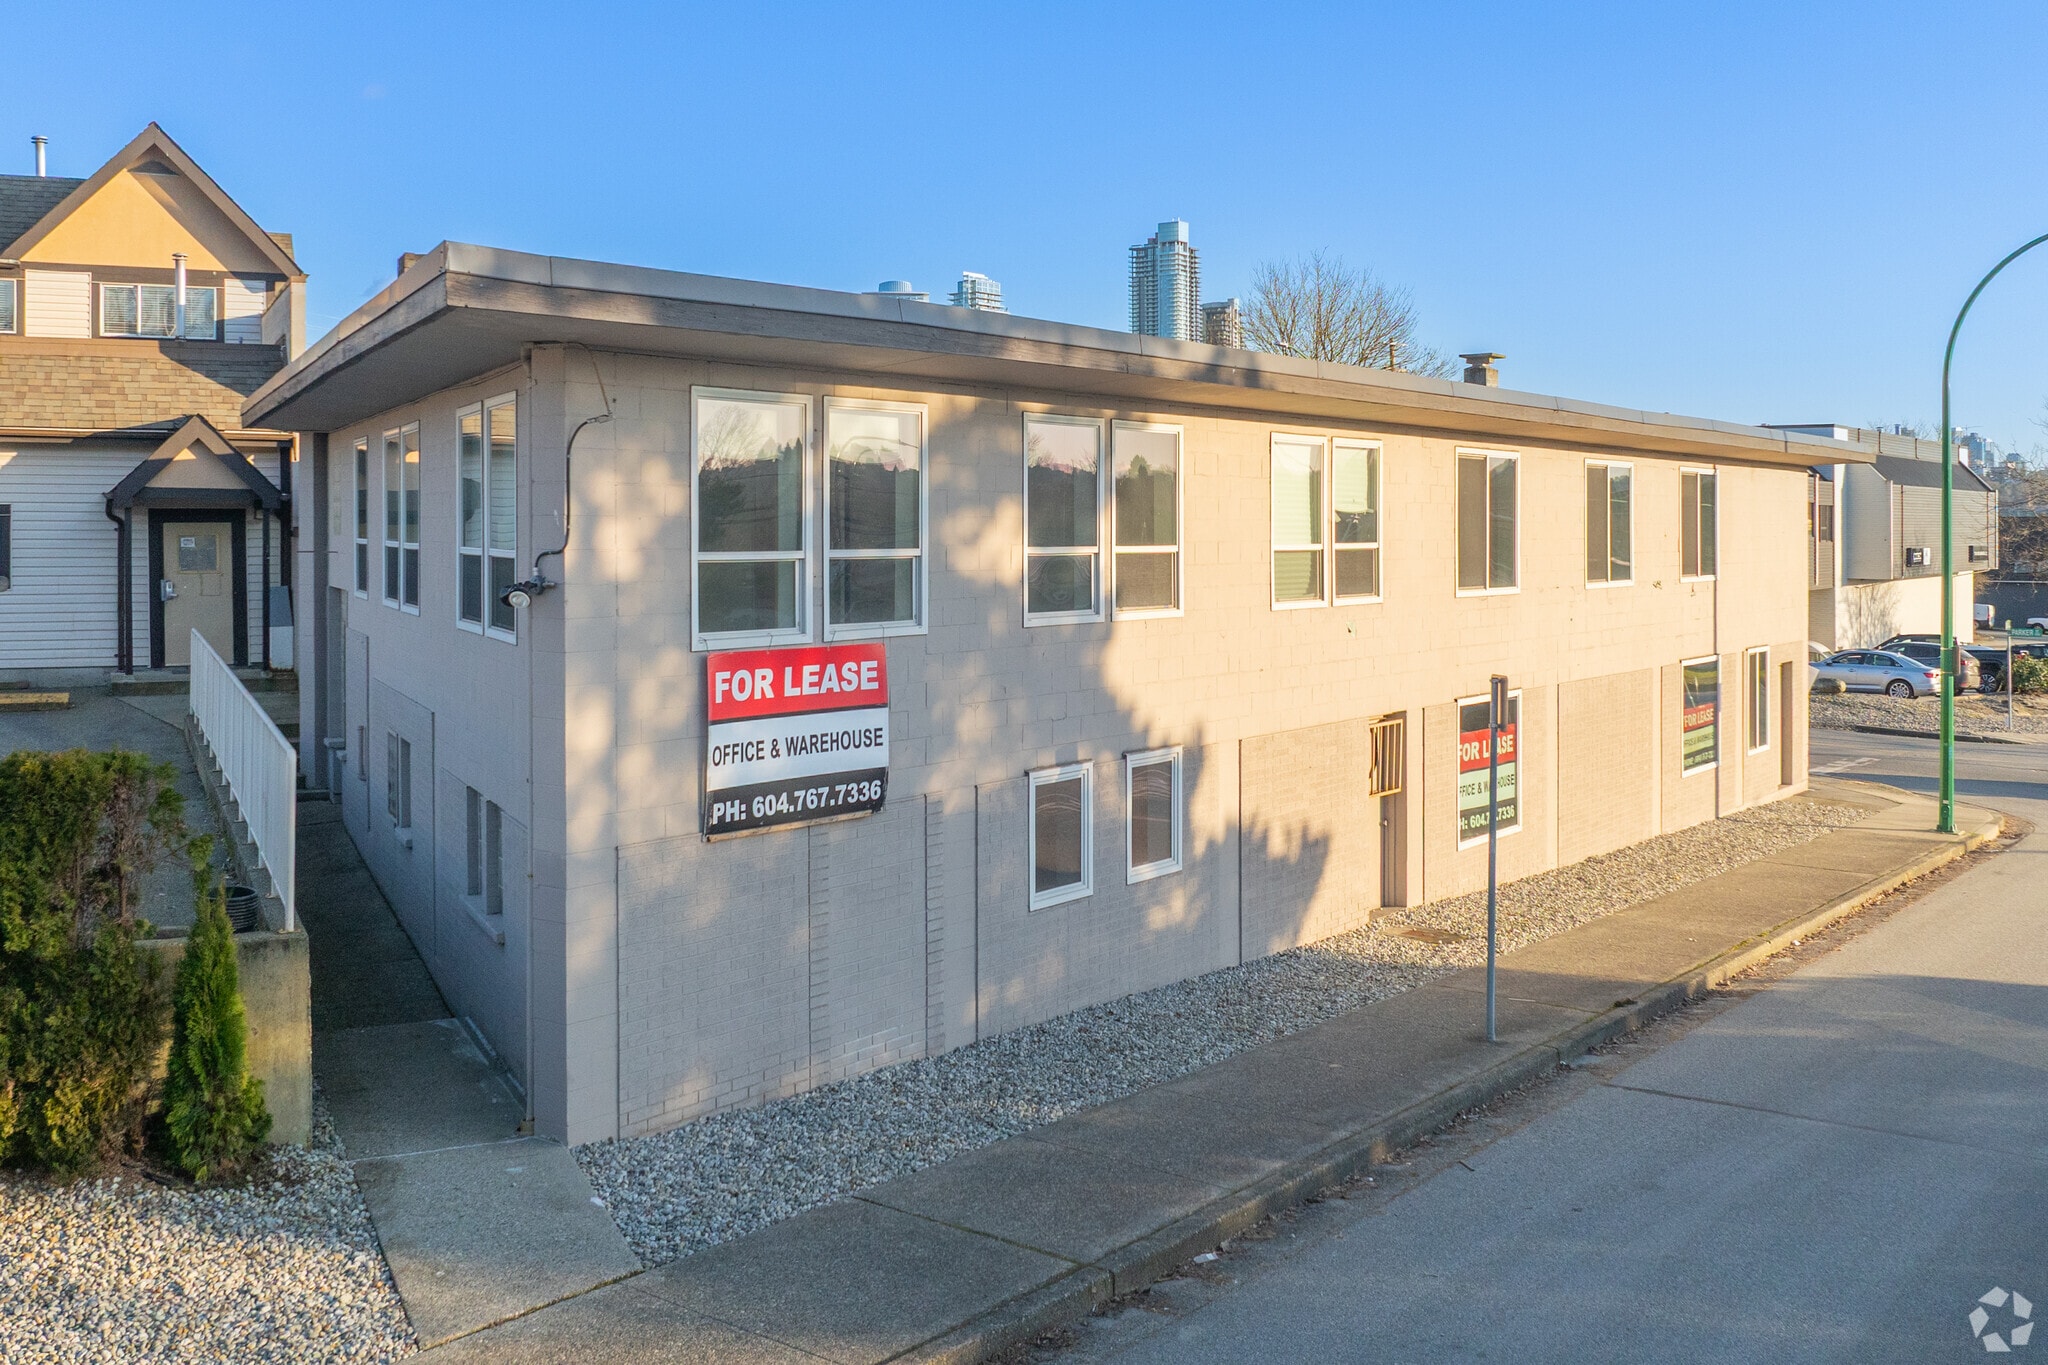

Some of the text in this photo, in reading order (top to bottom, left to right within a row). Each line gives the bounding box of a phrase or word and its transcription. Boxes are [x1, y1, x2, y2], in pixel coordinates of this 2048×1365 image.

[715, 660, 879, 703] FOR LEASE
[712, 727, 883, 766] OFFICE & WAREHOUSE
[1482, 734, 1514, 758] LASE
[712, 779, 882, 825] PH: 604.767.7336
[1477, 782, 1482, 794] &
[1470, 804, 1515, 828] 604.7.7336
